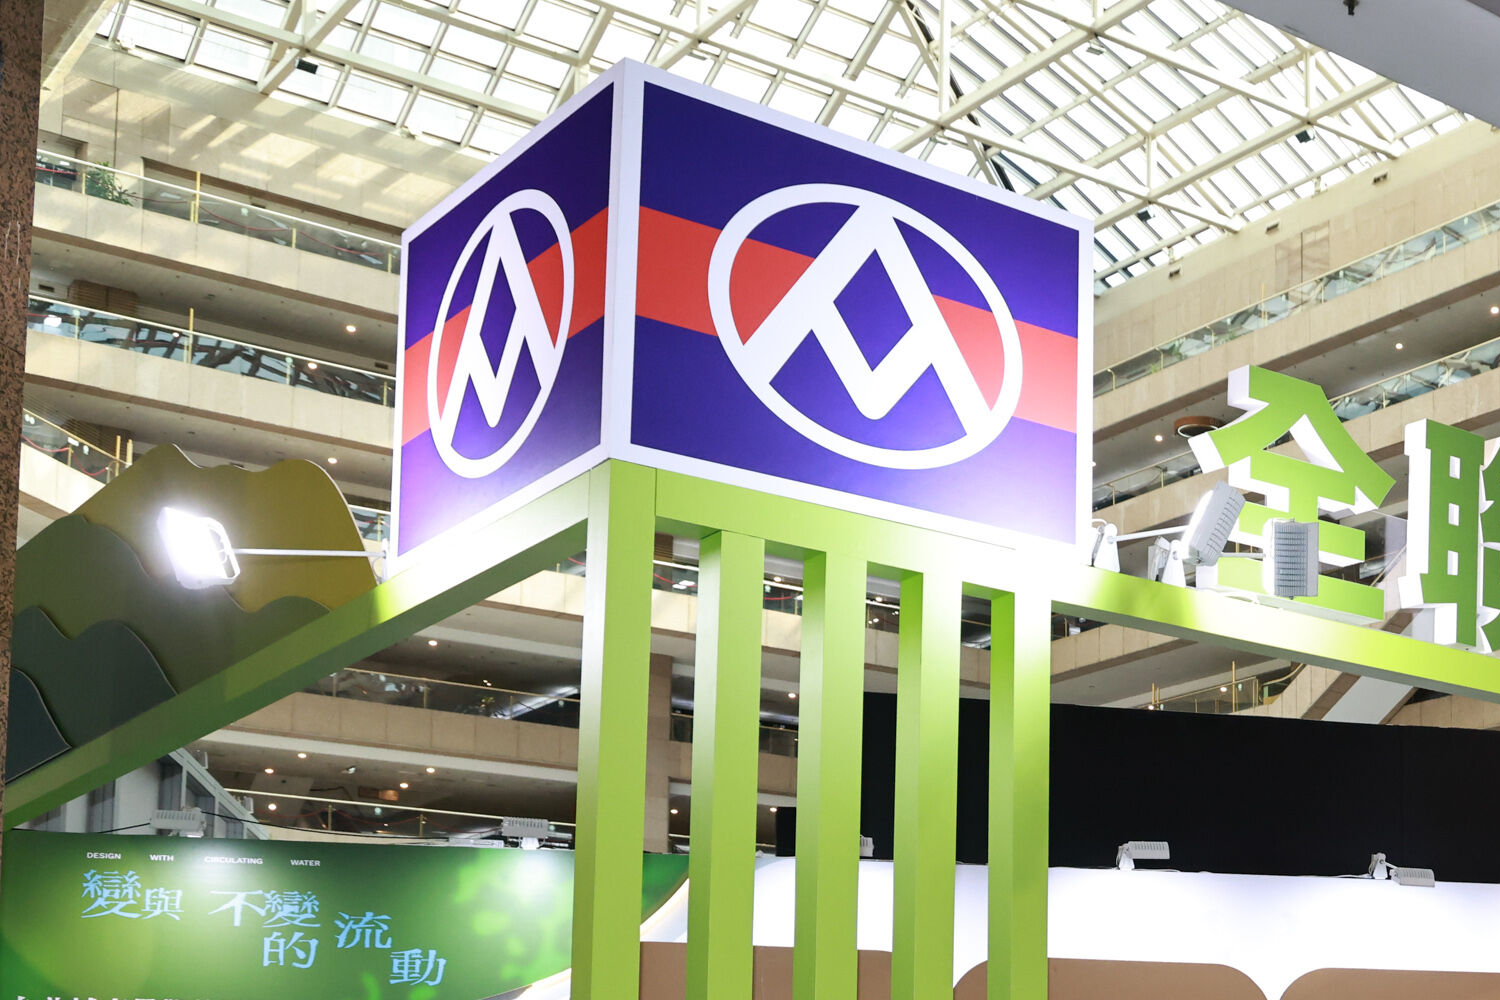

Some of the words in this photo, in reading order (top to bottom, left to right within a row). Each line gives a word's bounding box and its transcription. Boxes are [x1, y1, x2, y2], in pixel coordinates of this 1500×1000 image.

[86, 852, 122, 860] DESIGN
[149, 853, 174, 862] WITH
[204, 856, 263, 865] CIRCULATING
[290, 858, 321, 867] WATER
[81, 869, 183, 921] 變與
[262, 931, 319, 969] 的
